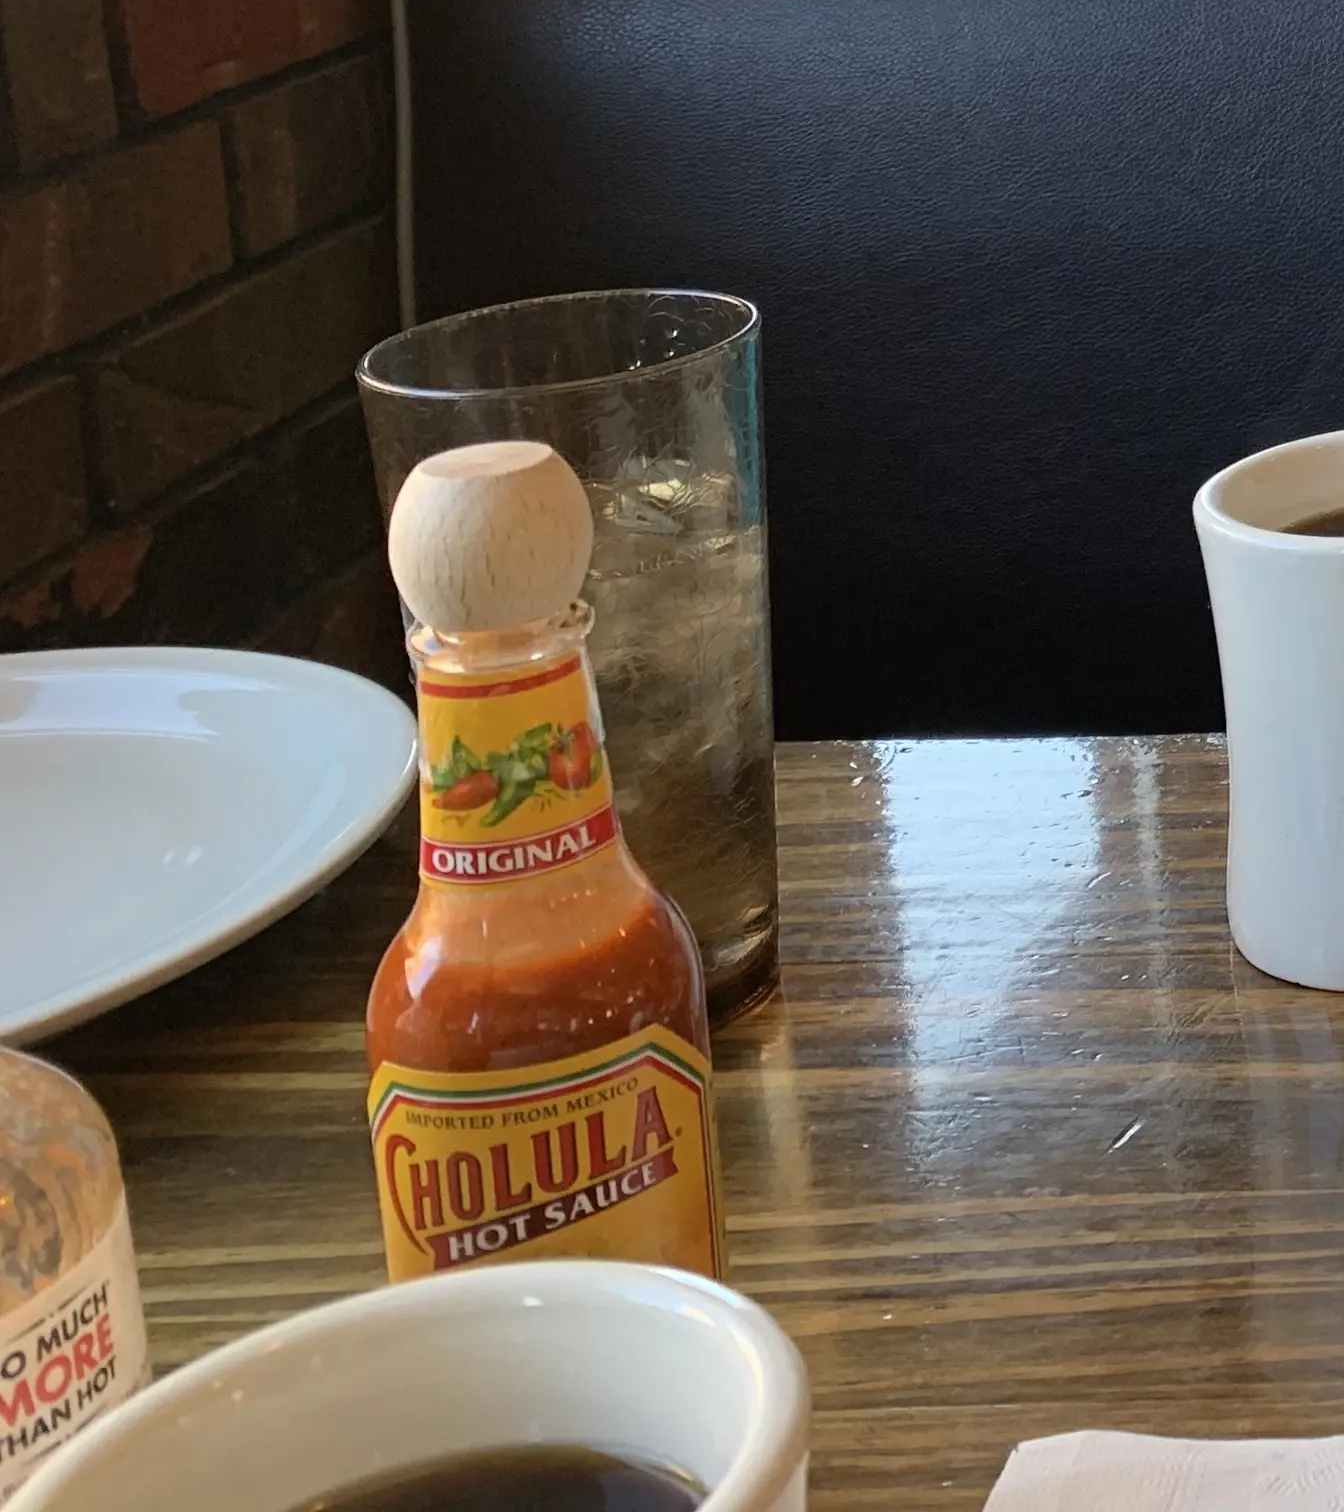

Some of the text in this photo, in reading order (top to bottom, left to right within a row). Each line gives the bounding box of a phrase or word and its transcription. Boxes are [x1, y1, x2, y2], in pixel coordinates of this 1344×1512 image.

[431, 825, 596, 875] ORIGINAL
[405, 1076, 639, 1131] IMPORTED FROM MEXICO
[385, 1085, 674, 1256] CHOLULA
[448, 1162, 658, 1262] HOT SAUCE
[36, 1285, 108, 1363] MUCH
[0, 1313, 114, 1428] MORE
[77, 1356, 117, 1411] HOT
